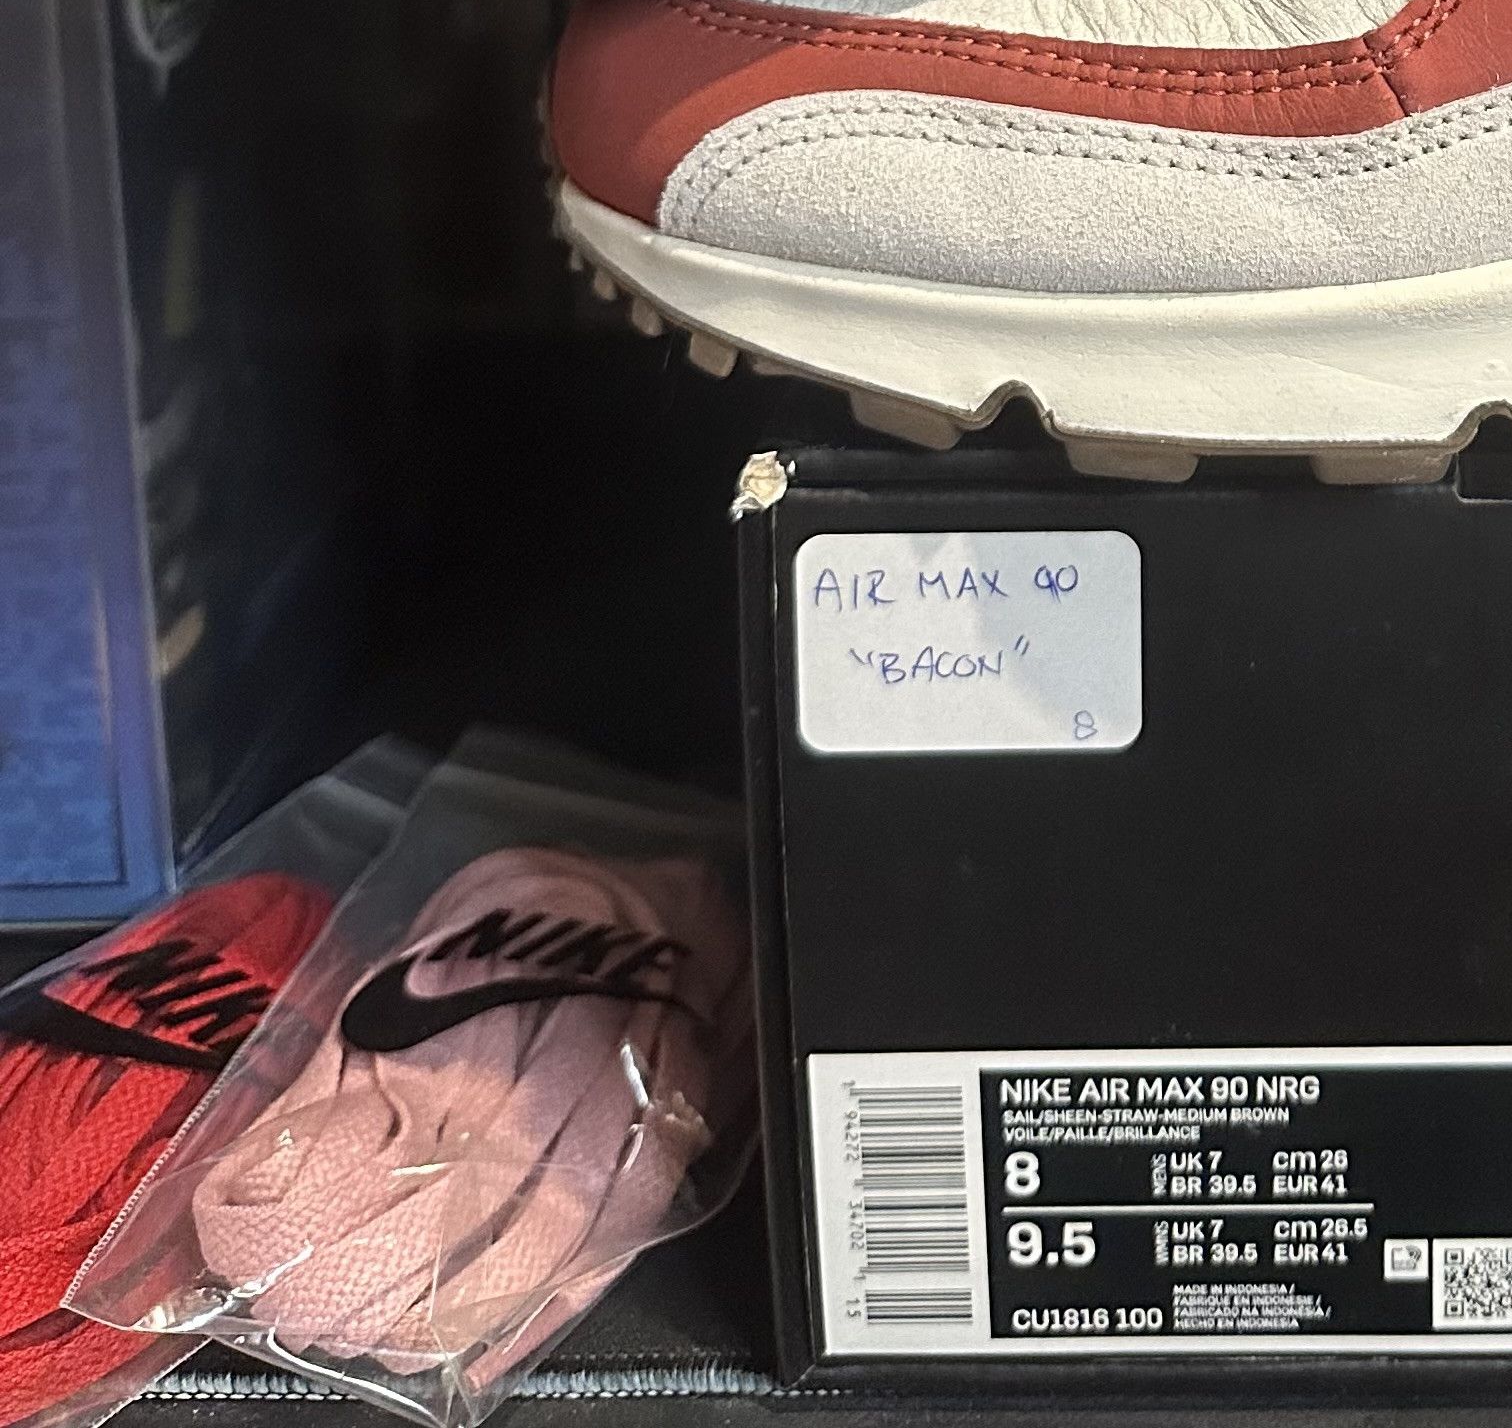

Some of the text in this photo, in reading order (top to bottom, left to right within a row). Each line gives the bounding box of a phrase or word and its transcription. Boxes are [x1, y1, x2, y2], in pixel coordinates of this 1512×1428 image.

[814, 564, 1079, 612] AIR MAX 90
[1073, 709, 1099, 741] 8
[426, 907, 693, 985] NIKE
[1001, 1075, 1321, 1104] NIKE AIR MAX 90 NRG
[1002, 1107, 1290, 1127] SAIL/SHEEN-STRAW-MEDIUM BROWN
[1003, 1125, 1201, 1143] VOILE/PAILLE/BRILLANCE
[1170, 1150, 1224, 1172] UK 7
[1272, 1149, 1348, 1171] cm 26
[1004, 1150, 1041, 1198] 8
[1170, 1174, 1257, 1196] BR 39.5
[1272, 1174, 1348, 1198] EUR 41
[1172, 1219, 1225, 1241] UK 7
[1273, 1218, 1369, 1241] cm 26.5
[1007, 1221, 1097, 1268] 9.5
[1172, 1243, 1258, 1267] BR 39.5
[1273, 1242, 1349, 1266] EUR 41
[1173, 1283, 1207, 1295] MADE
[1210, 1283, 1223, 1295] IN
[1225, 1283, 1287, 1295] INDONESIA
[1233, 1295, 1250, 1306] EN
[1012, 1306, 1164, 1334] CU1816 100
[1242, 1306, 1259, 1318] NA
[1217, 1318, 1234, 1330] EN
